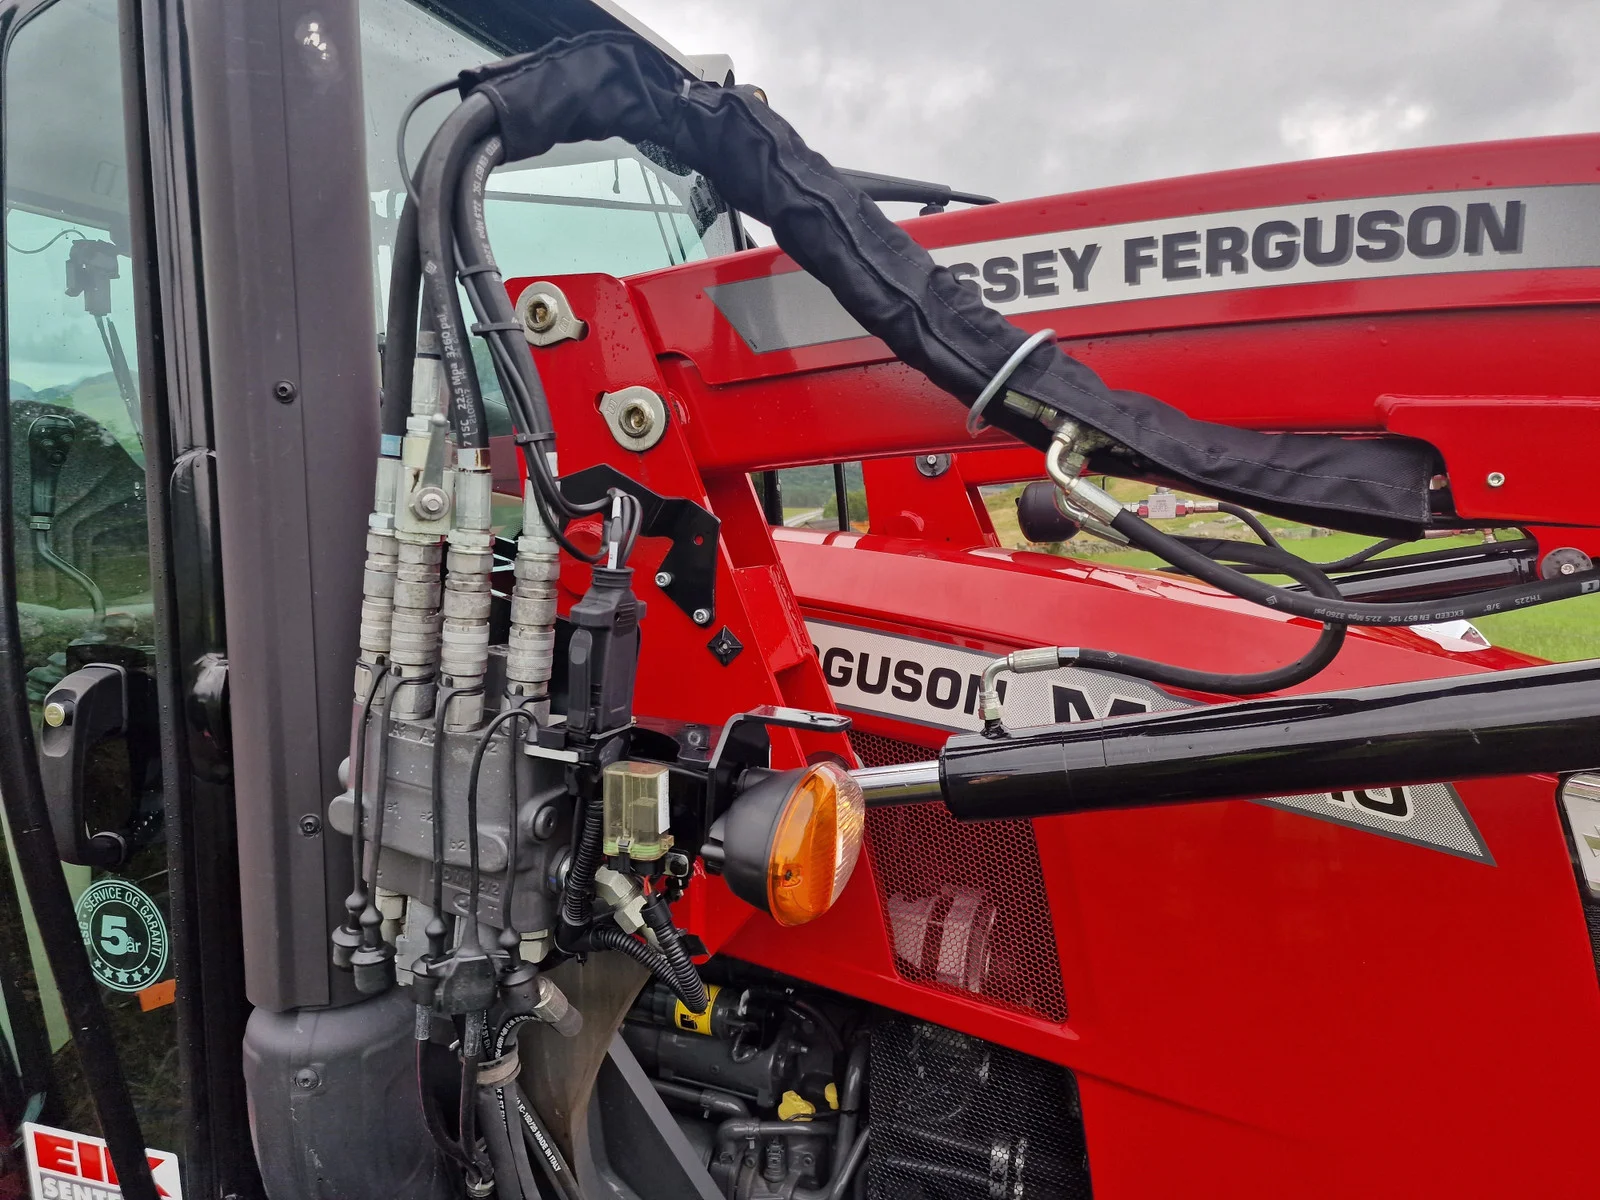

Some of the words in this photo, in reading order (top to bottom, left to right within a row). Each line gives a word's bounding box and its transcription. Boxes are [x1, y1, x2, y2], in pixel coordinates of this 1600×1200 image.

[1124, 200, 1526, 287] FERGUSON
[442, 332, 456, 358] 3260
[451, 363, 462, 387] Mpa
[454, 389, 467, 411] 22.5
[460, 419, 472, 438] 1SC
[1435, 609, 1464, 620] EXCEED
[814, 644, 1007, 715] GUSON
[84, 887, 122, 912] SERVICE
[124, 891, 140, 908] OG
[140, 905, 162, 957] GARANTI
[534, 1130, 549, 1151] MADE
[544, 1147, 553, 1157] IN
[548, 1154, 562, 1172] ITALY
